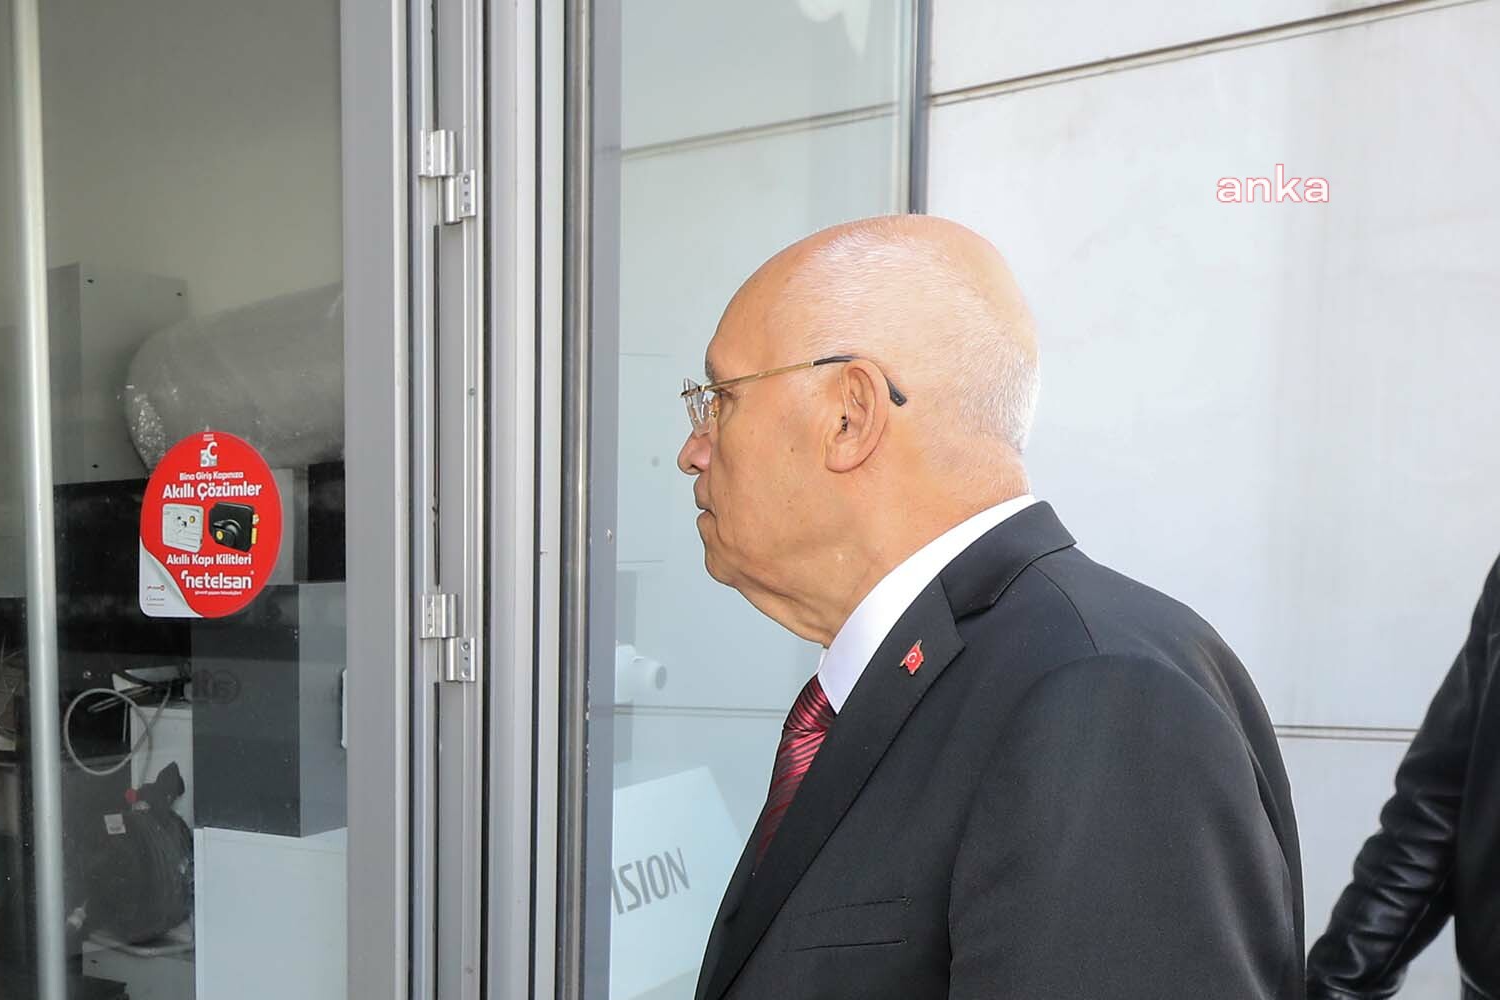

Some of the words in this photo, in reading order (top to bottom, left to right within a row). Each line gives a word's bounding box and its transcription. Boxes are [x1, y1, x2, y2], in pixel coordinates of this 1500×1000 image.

[196, 471, 213, 482] Giriş
[162, 483, 195, 499] Akıllı
[197, 480, 262, 501] Çözümler
[166, 553, 190, 565] Akıllı
[192, 554, 214, 567] Kapı
[215, 553, 252, 565] Kilitleri
[181, 569, 252, 590] netelsan
